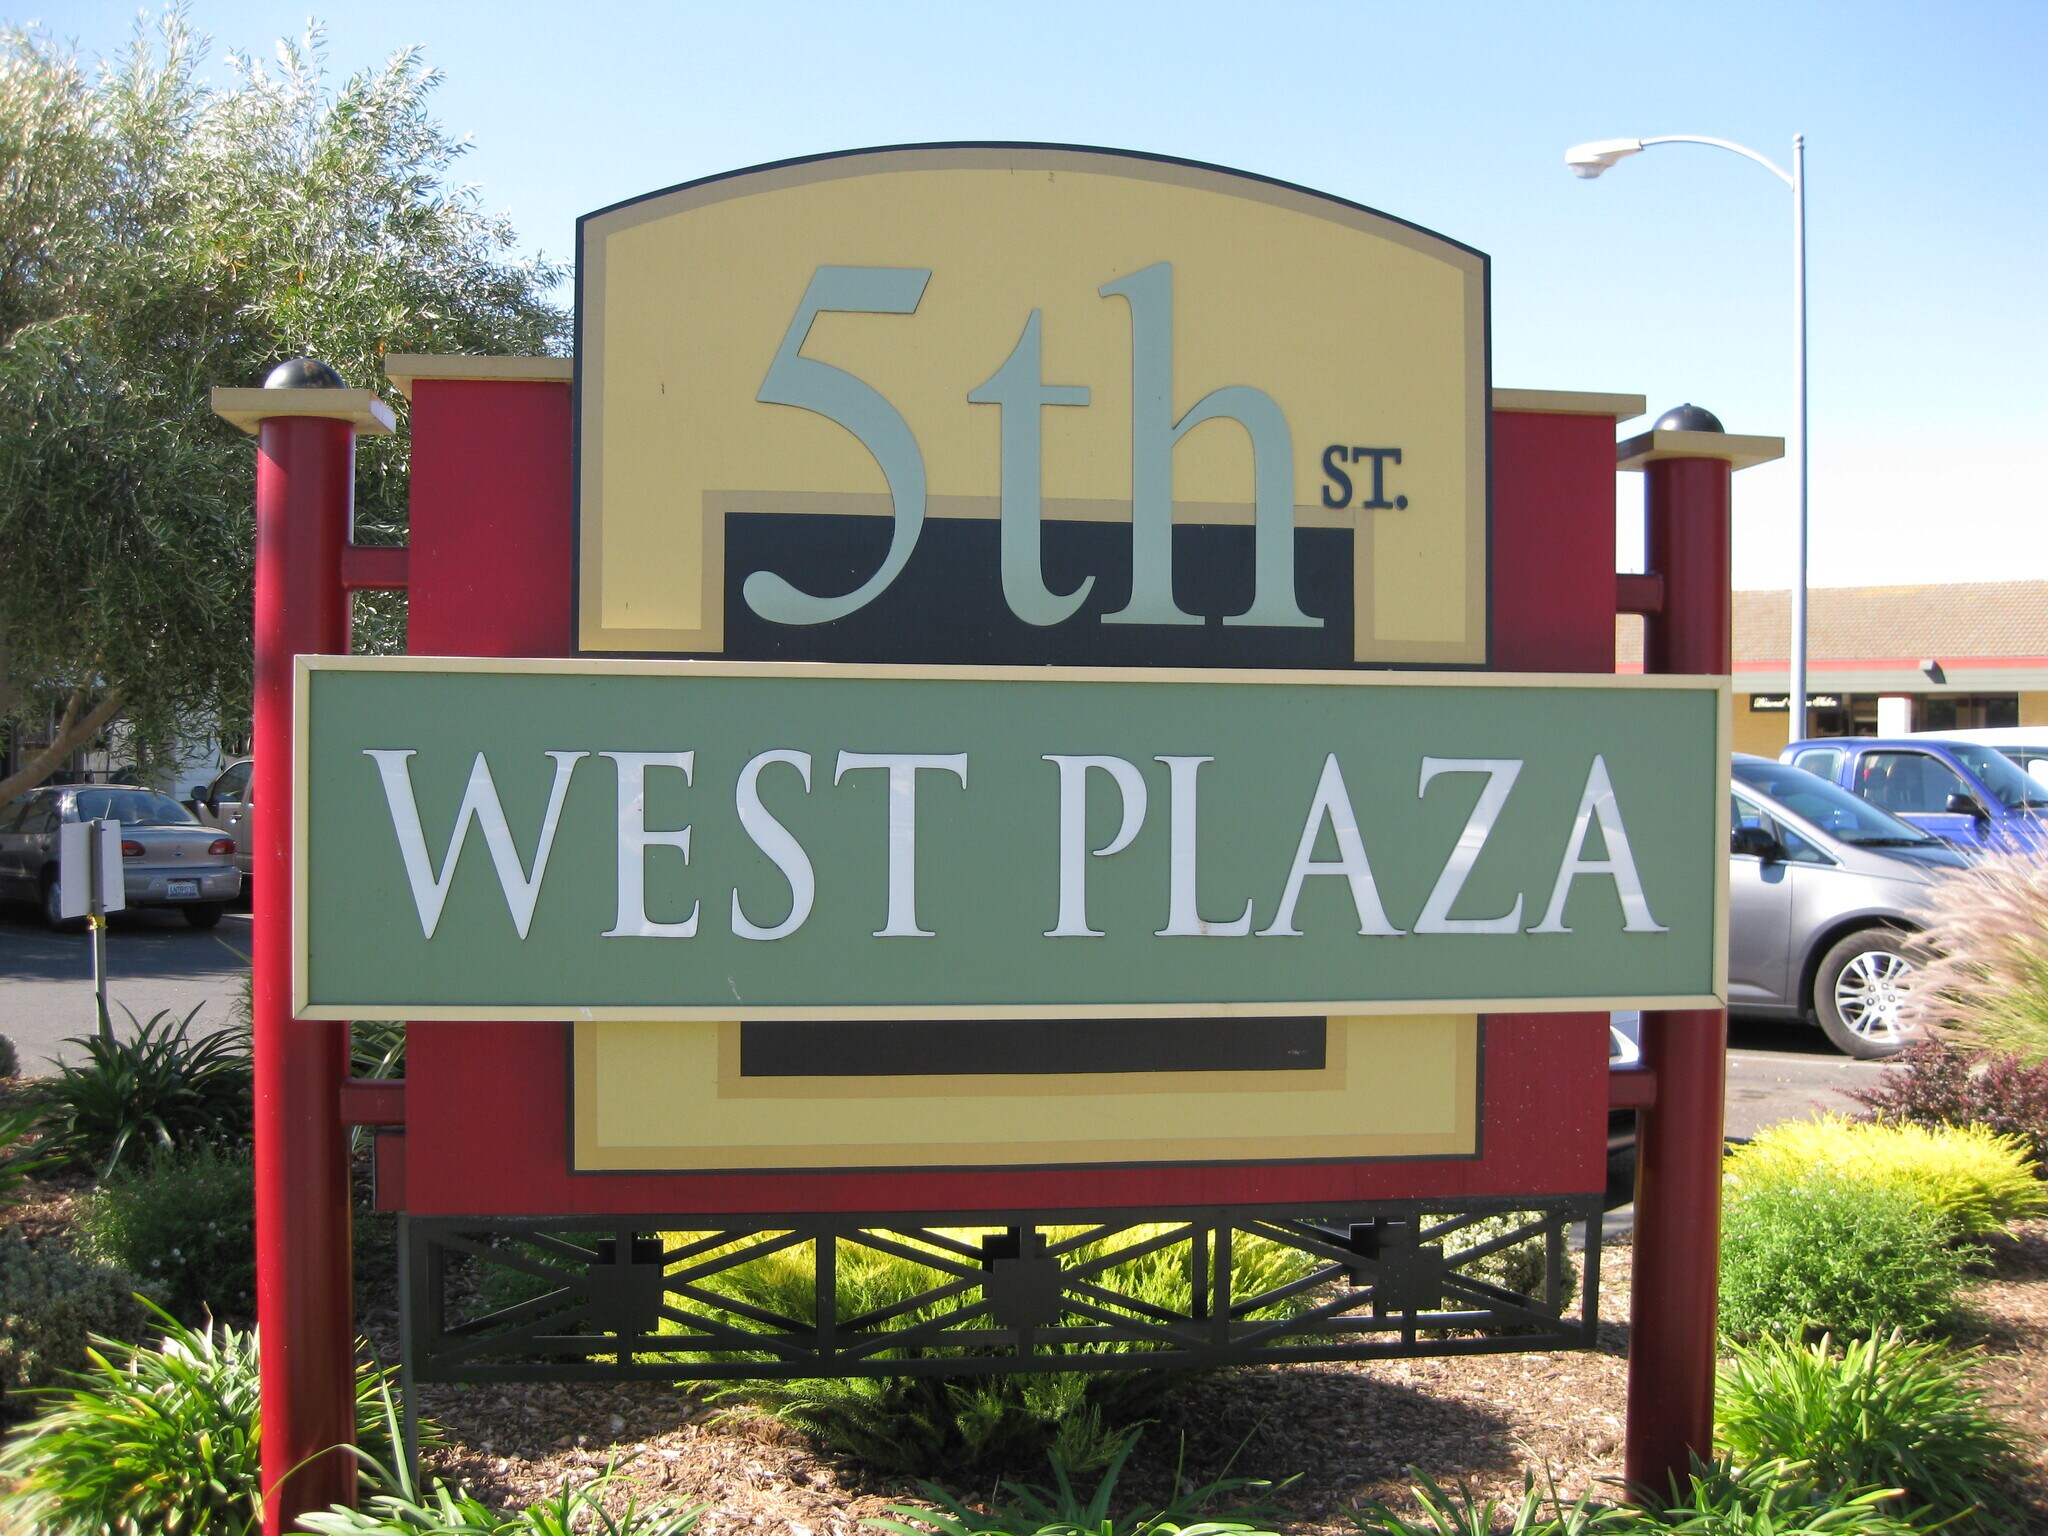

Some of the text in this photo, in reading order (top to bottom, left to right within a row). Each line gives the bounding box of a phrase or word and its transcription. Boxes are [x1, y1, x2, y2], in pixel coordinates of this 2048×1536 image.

[742, 261, 1409, 628] 5th ST.
[362, 748, 1670, 942] WEST PLAZA
